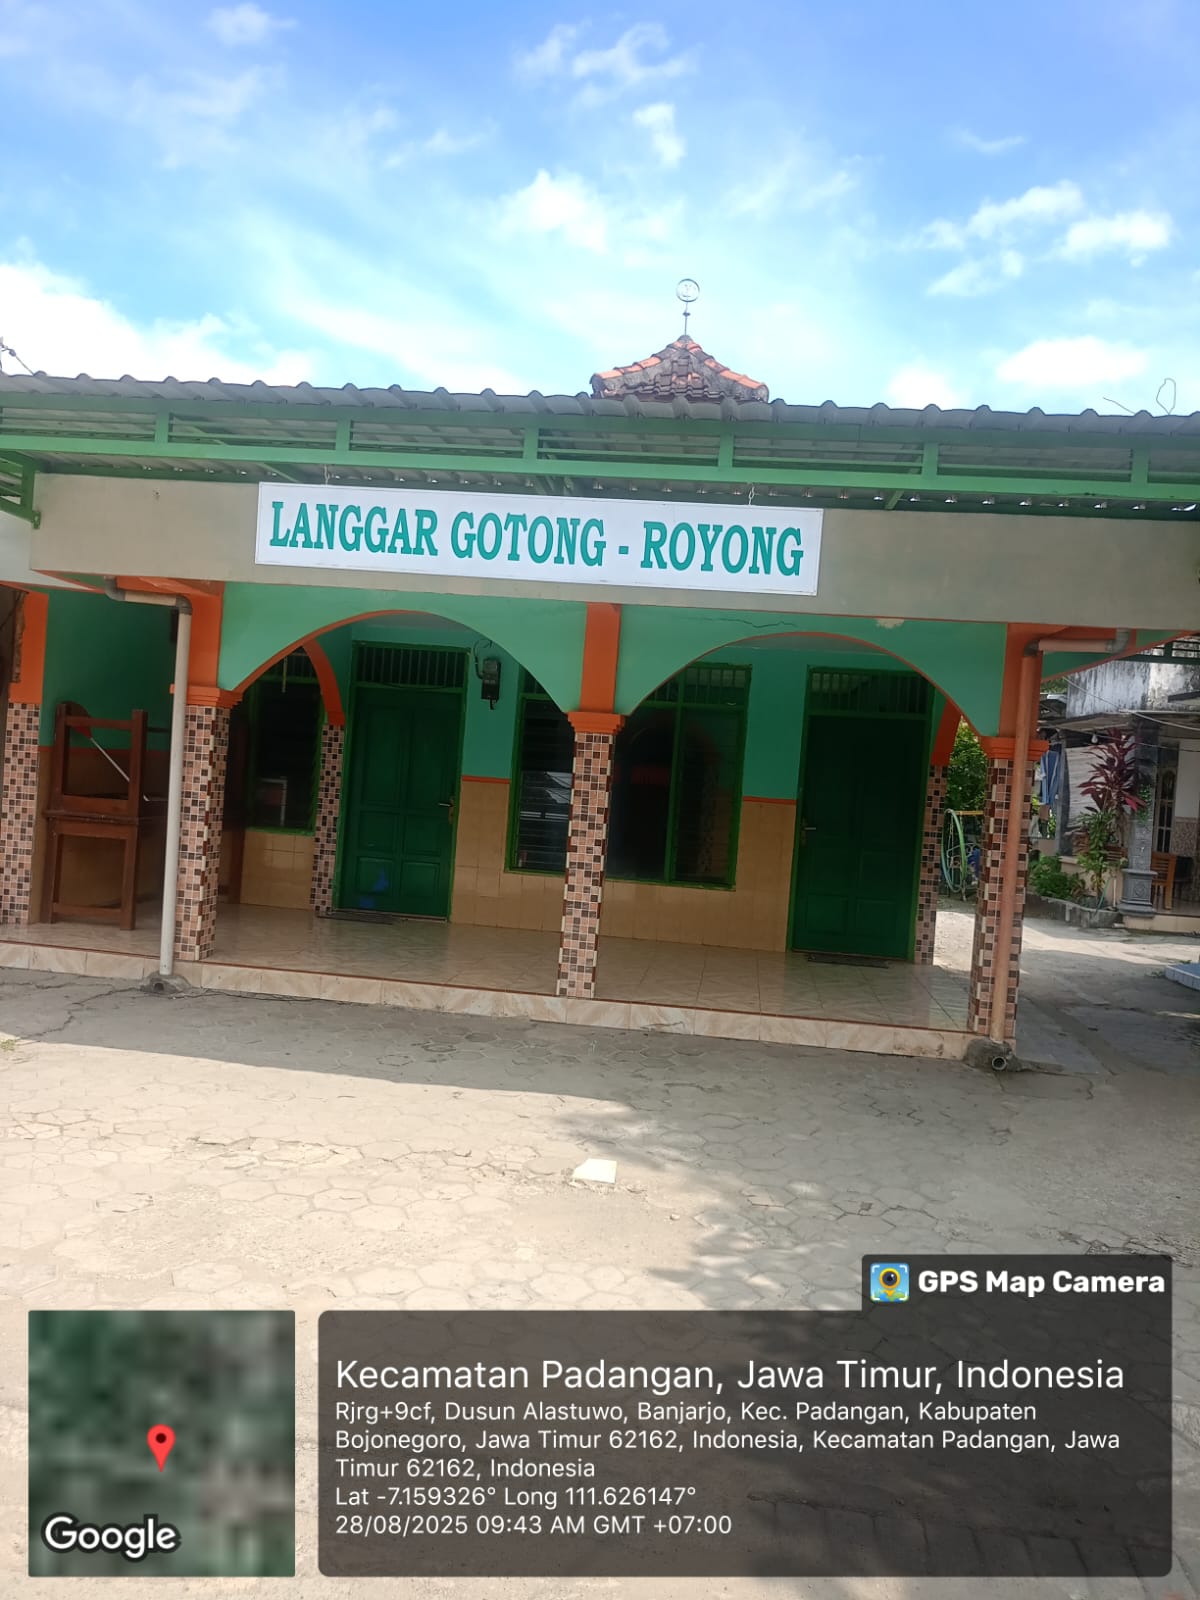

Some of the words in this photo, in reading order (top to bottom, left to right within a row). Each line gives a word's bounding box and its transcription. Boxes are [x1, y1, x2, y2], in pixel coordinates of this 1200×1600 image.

[270, 500, 439, 557] LANGGAR
[450, 511, 607, 567] GOTONG
[618, 545, 630, 555] -
[640, 520, 804, 577] ROYONG
